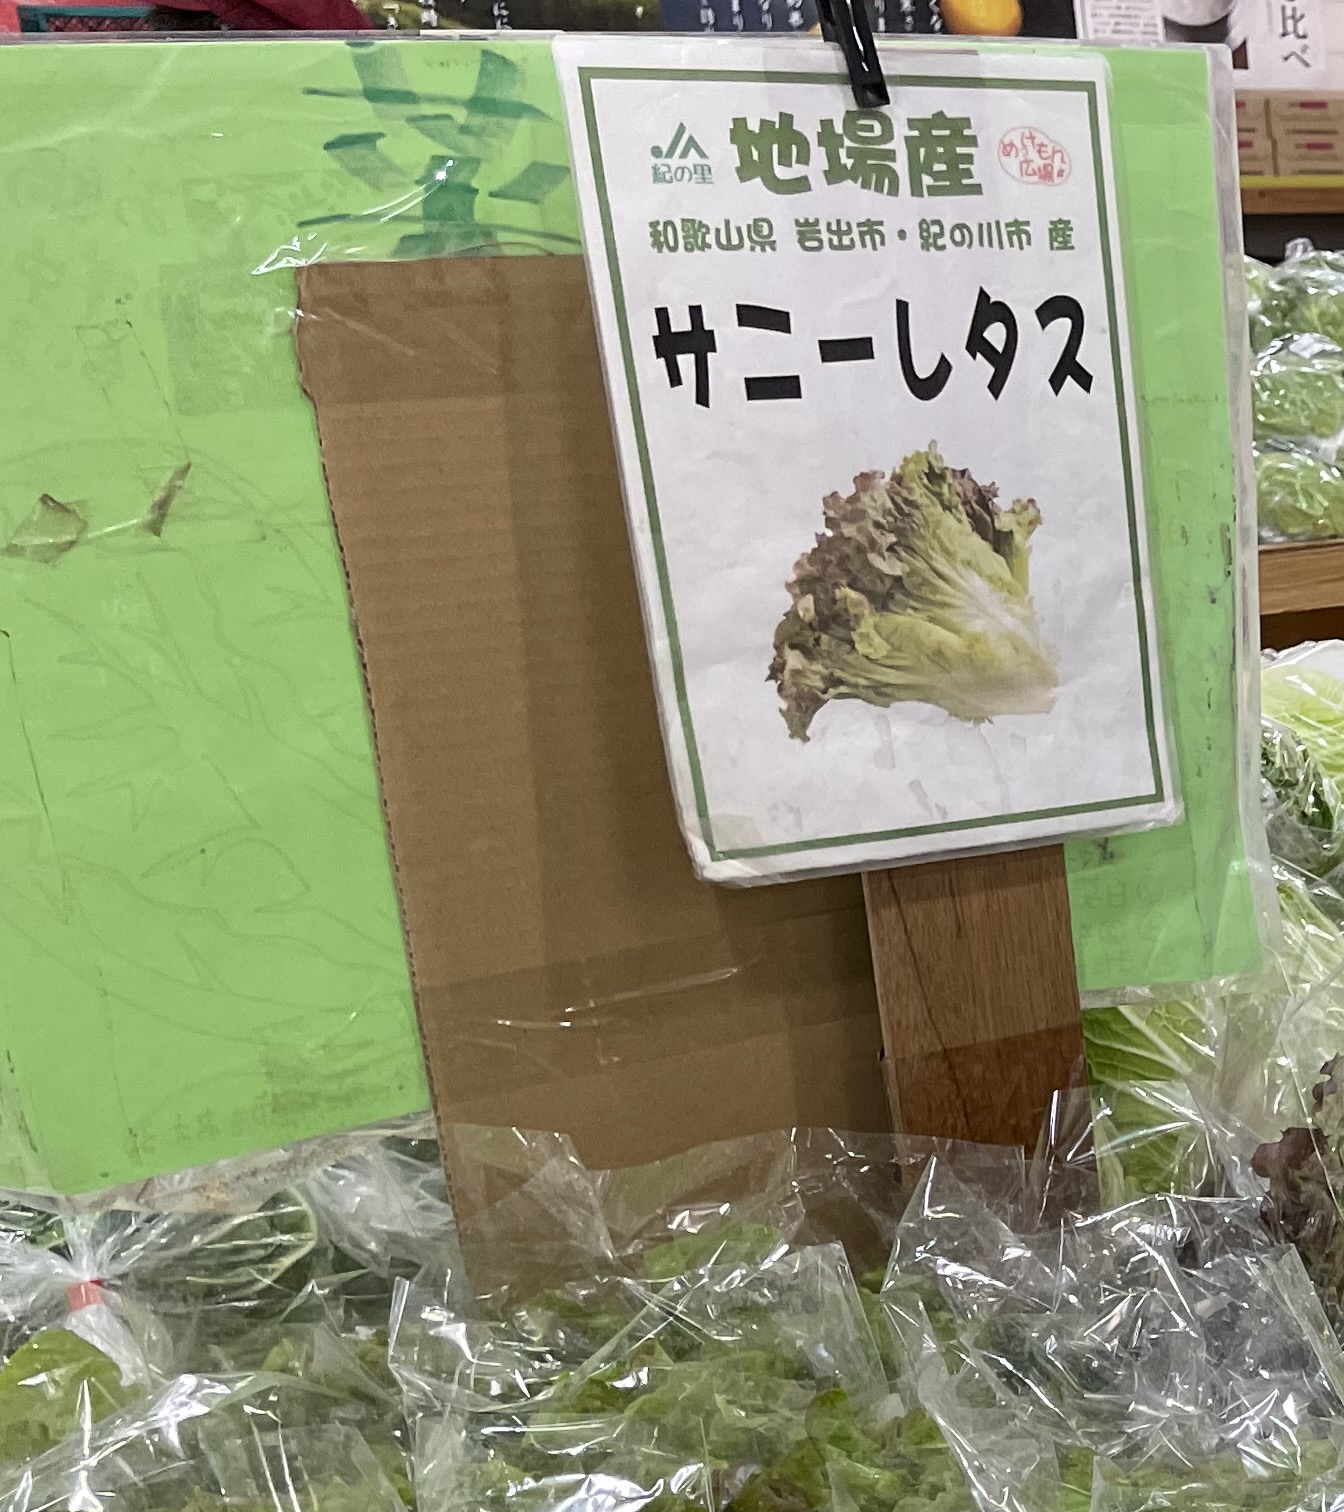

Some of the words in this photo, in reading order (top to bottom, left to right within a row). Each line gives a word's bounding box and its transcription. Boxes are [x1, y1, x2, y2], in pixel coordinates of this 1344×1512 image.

[729, 110, 984, 198] 地場産
[652, 162, 714, 185] 紀の里
[649, 218, 777, 253] 和歌山県
[794, 218, 1032, 252] 岩出市・紀の川市
[1047, 219, 1076, 252] 産
